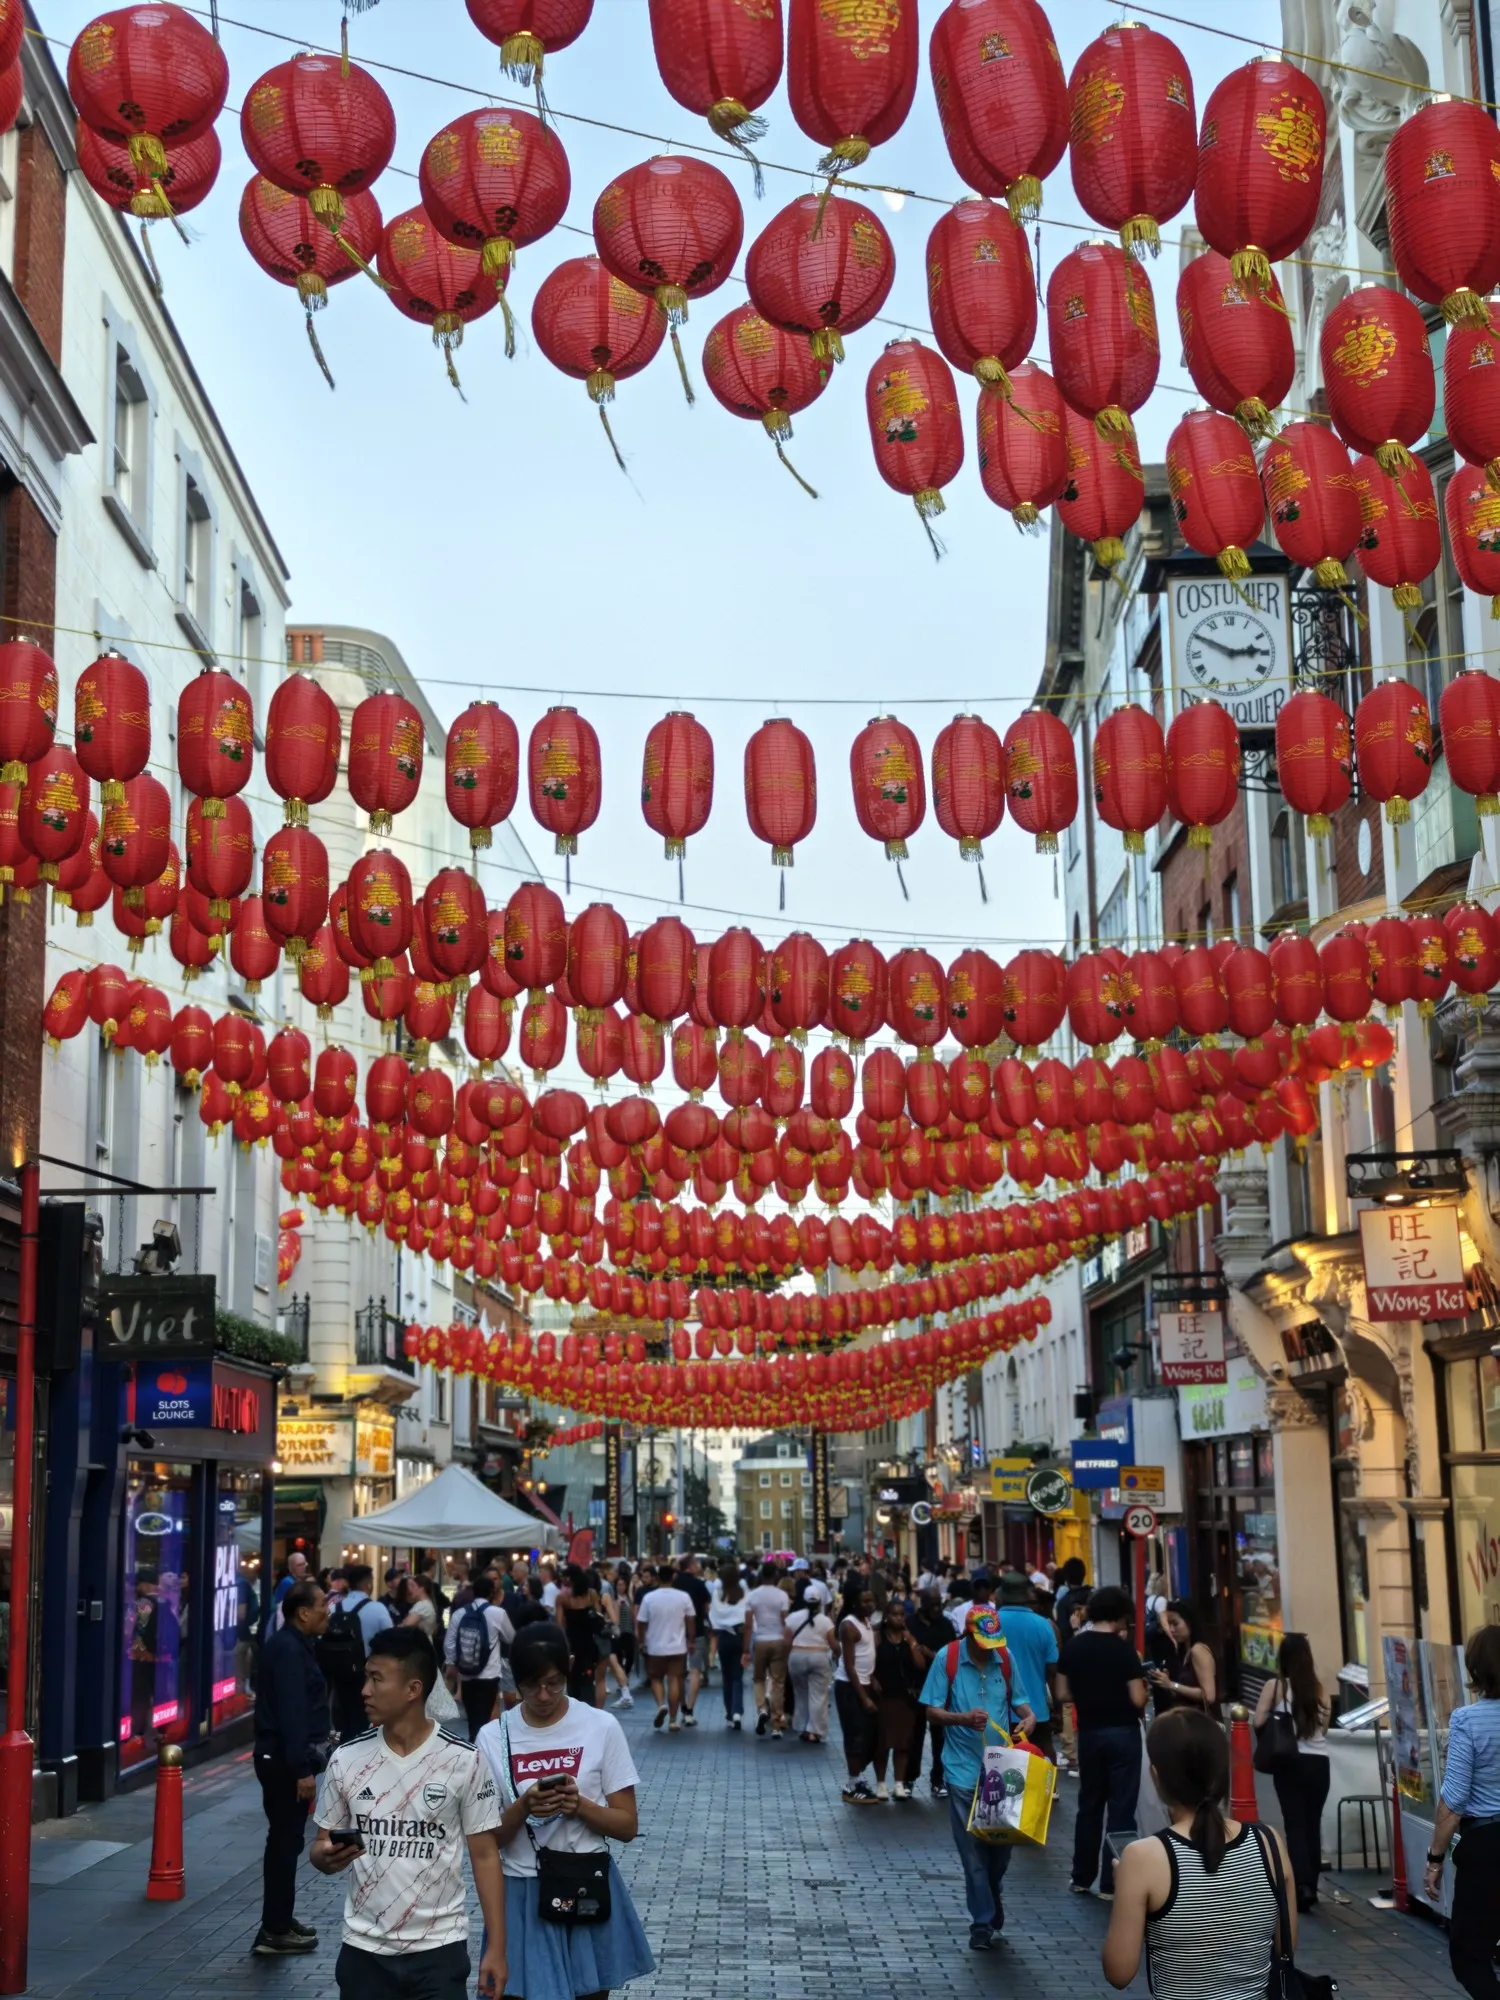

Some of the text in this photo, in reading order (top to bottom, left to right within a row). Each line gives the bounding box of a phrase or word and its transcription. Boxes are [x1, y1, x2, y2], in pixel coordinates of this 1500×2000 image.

[1177, 582, 1280, 620] COSTUMIER
[1388, 1212, 1437, 1280] 旺記
[1372, 1289, 1465, 1316] Wong Kei
[111, 1301, 198, 1342] Viet
[1165, 1364, 1225, 1382] Wong Kei
[152, 1410, 195, 1420] LOUNGE
[158, 1400, 190, 1409] SLOTS
[1075, 1459, 1118, 1469] BETFRED
[1130, 1514, 1153, 1528] 20
[356, 1814, 446, 1840] Emirates
[368, 1838, 435, 1859] FLY BETTER
